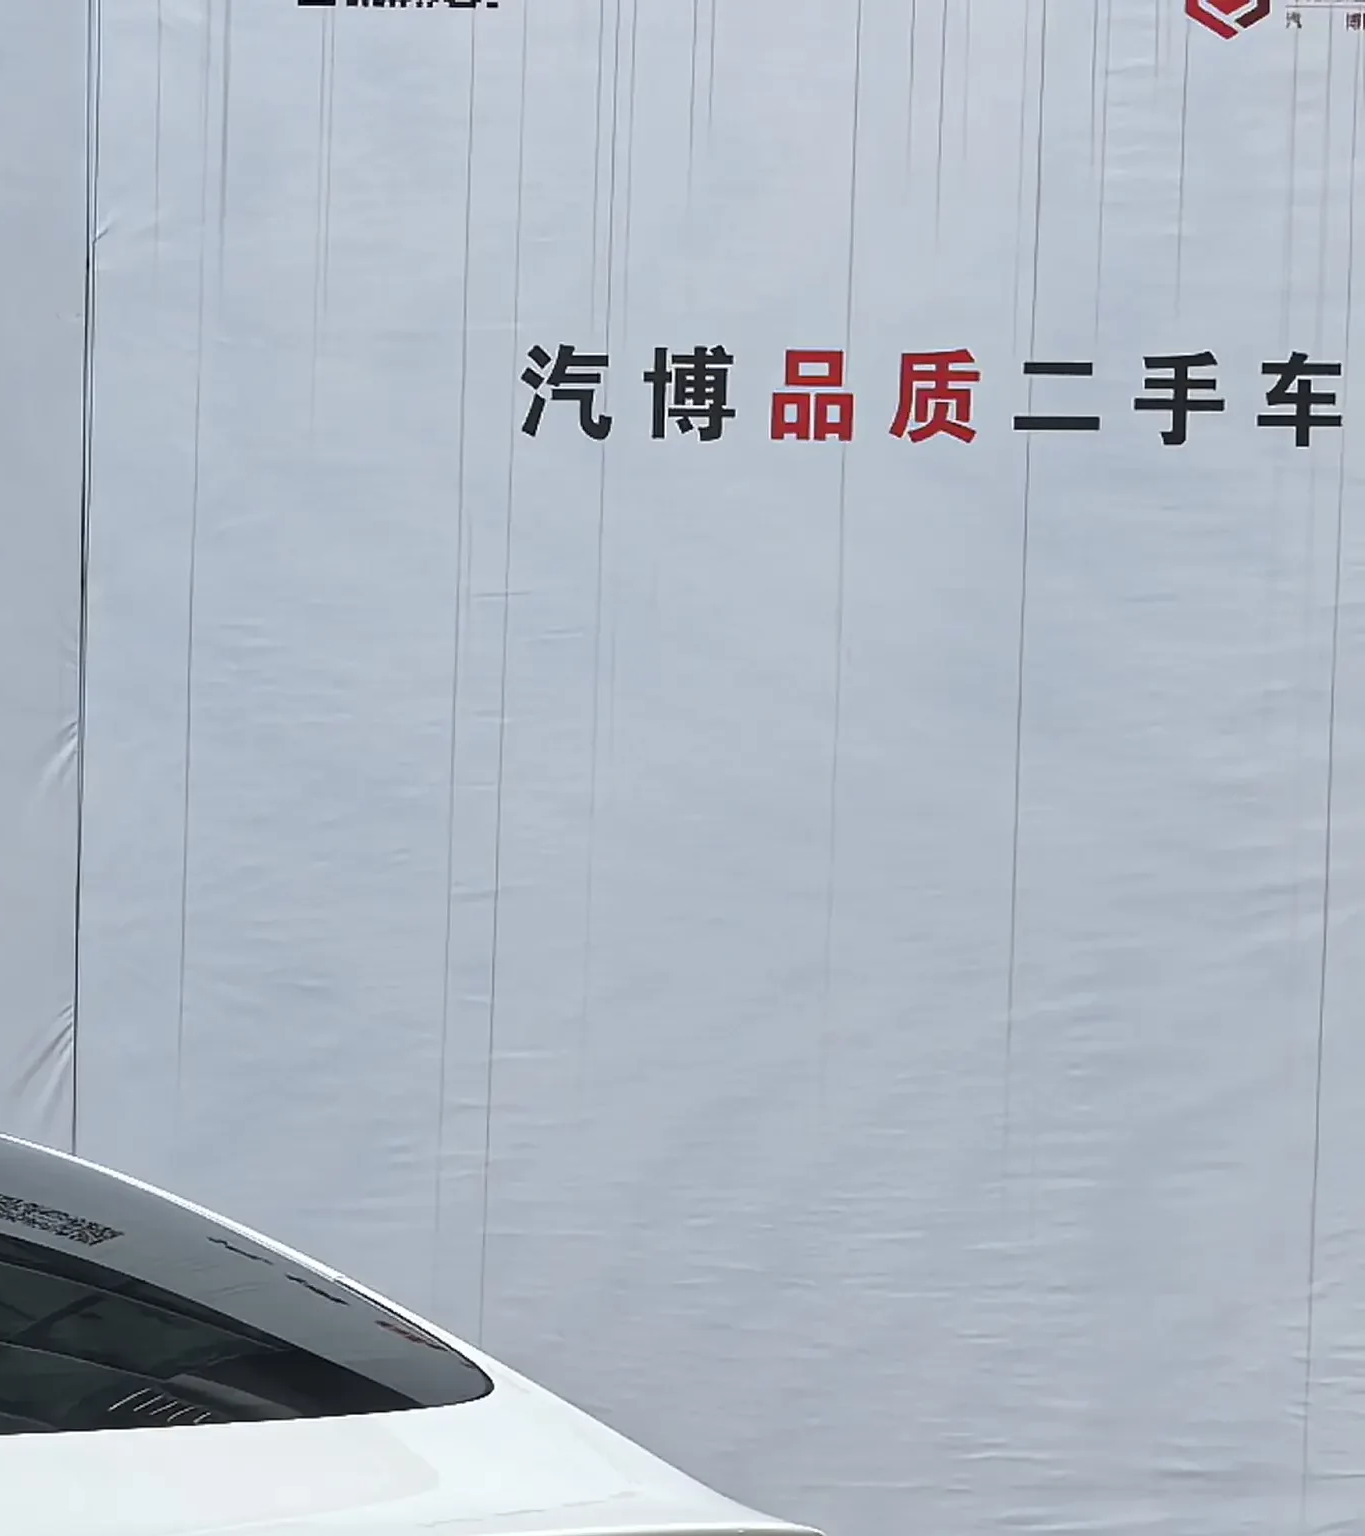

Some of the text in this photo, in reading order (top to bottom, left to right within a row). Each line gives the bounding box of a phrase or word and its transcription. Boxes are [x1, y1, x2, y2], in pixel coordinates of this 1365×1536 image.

[520, 343, 1344, 447] 汽博品质二手车
